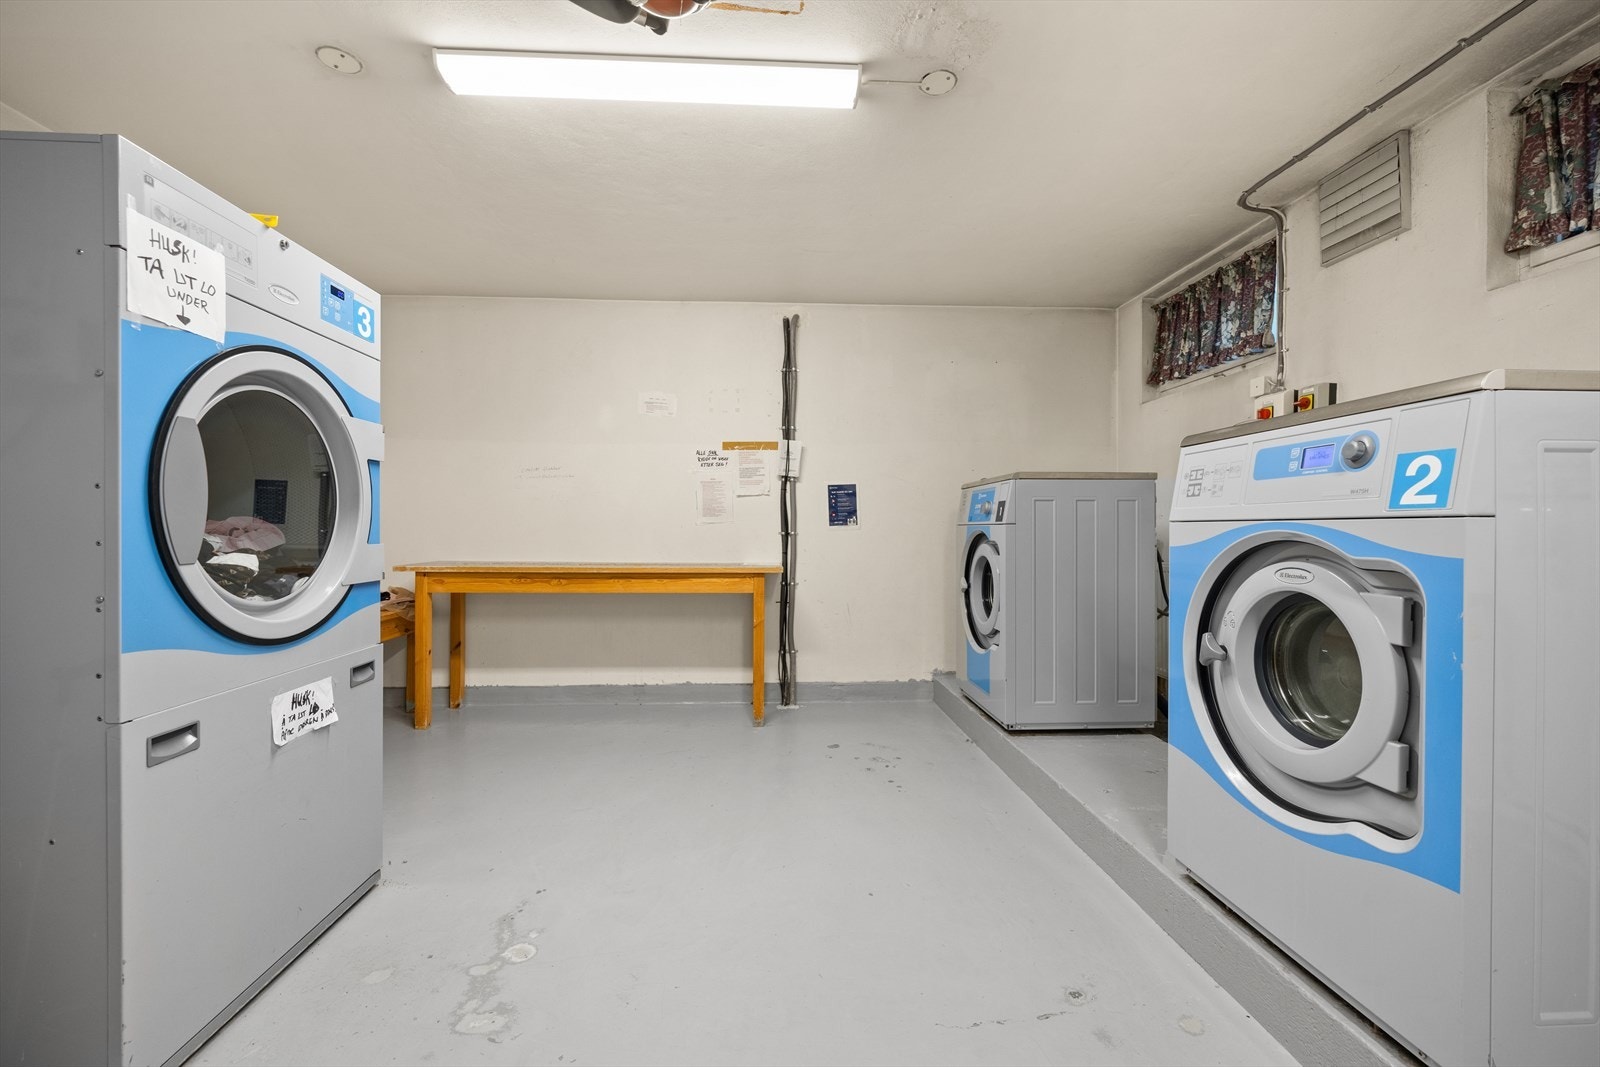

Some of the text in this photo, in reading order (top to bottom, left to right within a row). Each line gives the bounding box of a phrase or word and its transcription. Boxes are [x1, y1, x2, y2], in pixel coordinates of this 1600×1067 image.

[148, 228, 196, 264] HUSK!
[137, 256, 216, 297] TA UT LO
[166, 285, 209, 315] UNDER
[357, 306, 372, 338] 3
[1399, 454, 1443, 506] 2
[1284, 572, 1307, 580] Electrolux
[291, 689, 315, 711] HUSK!
